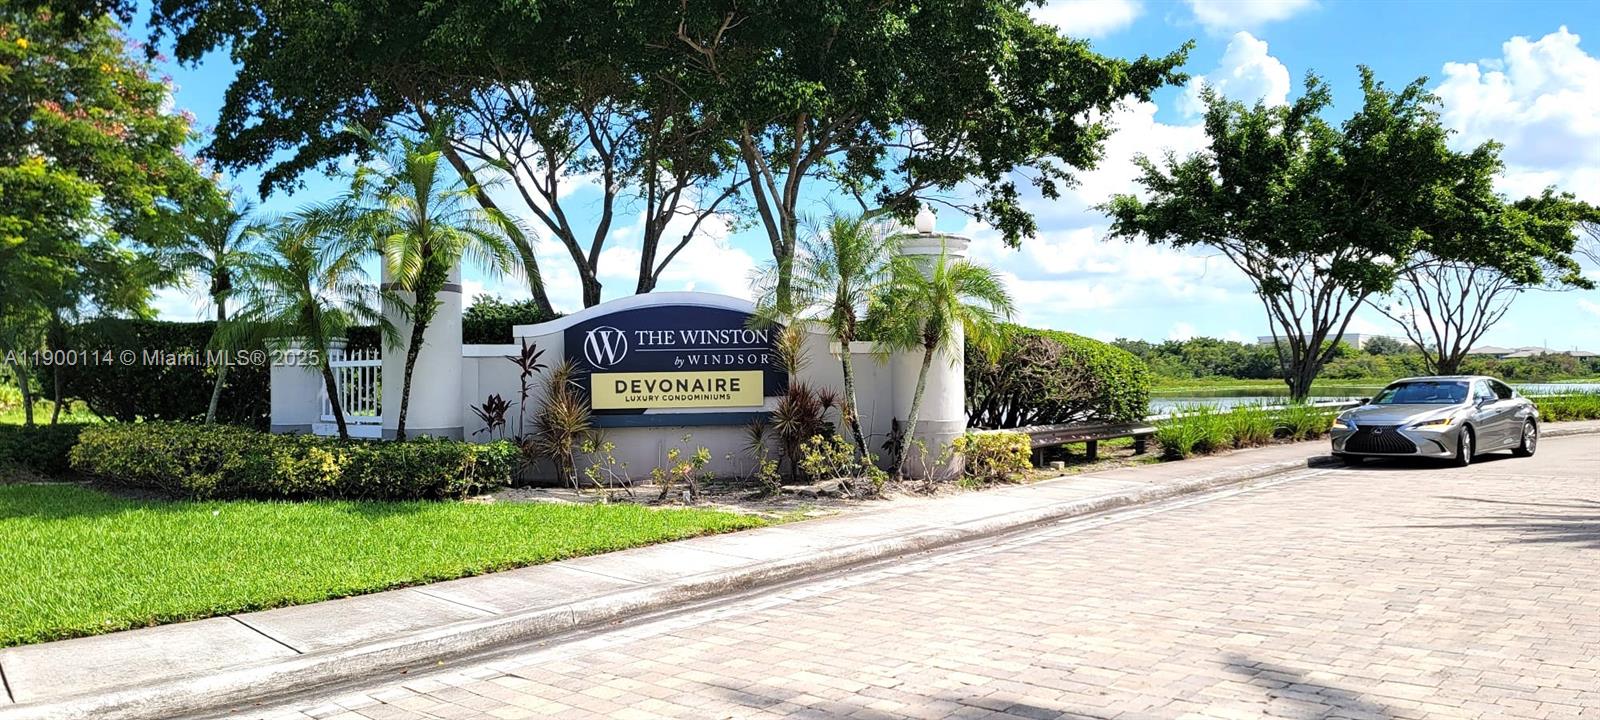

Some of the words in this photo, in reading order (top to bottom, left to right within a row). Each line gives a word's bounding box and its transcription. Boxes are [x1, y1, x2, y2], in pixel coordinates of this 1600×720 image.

[635, 329, 675, 346] THE
[680, 329, 768, 345] WINSTON
[674, 356, 685, 368] by
[688, 354, 769, 365] WINDSOR
[615, 378, 741, 394] DEVONAIRE
[662, 393, 731, 401] CONDOMINIUMS
